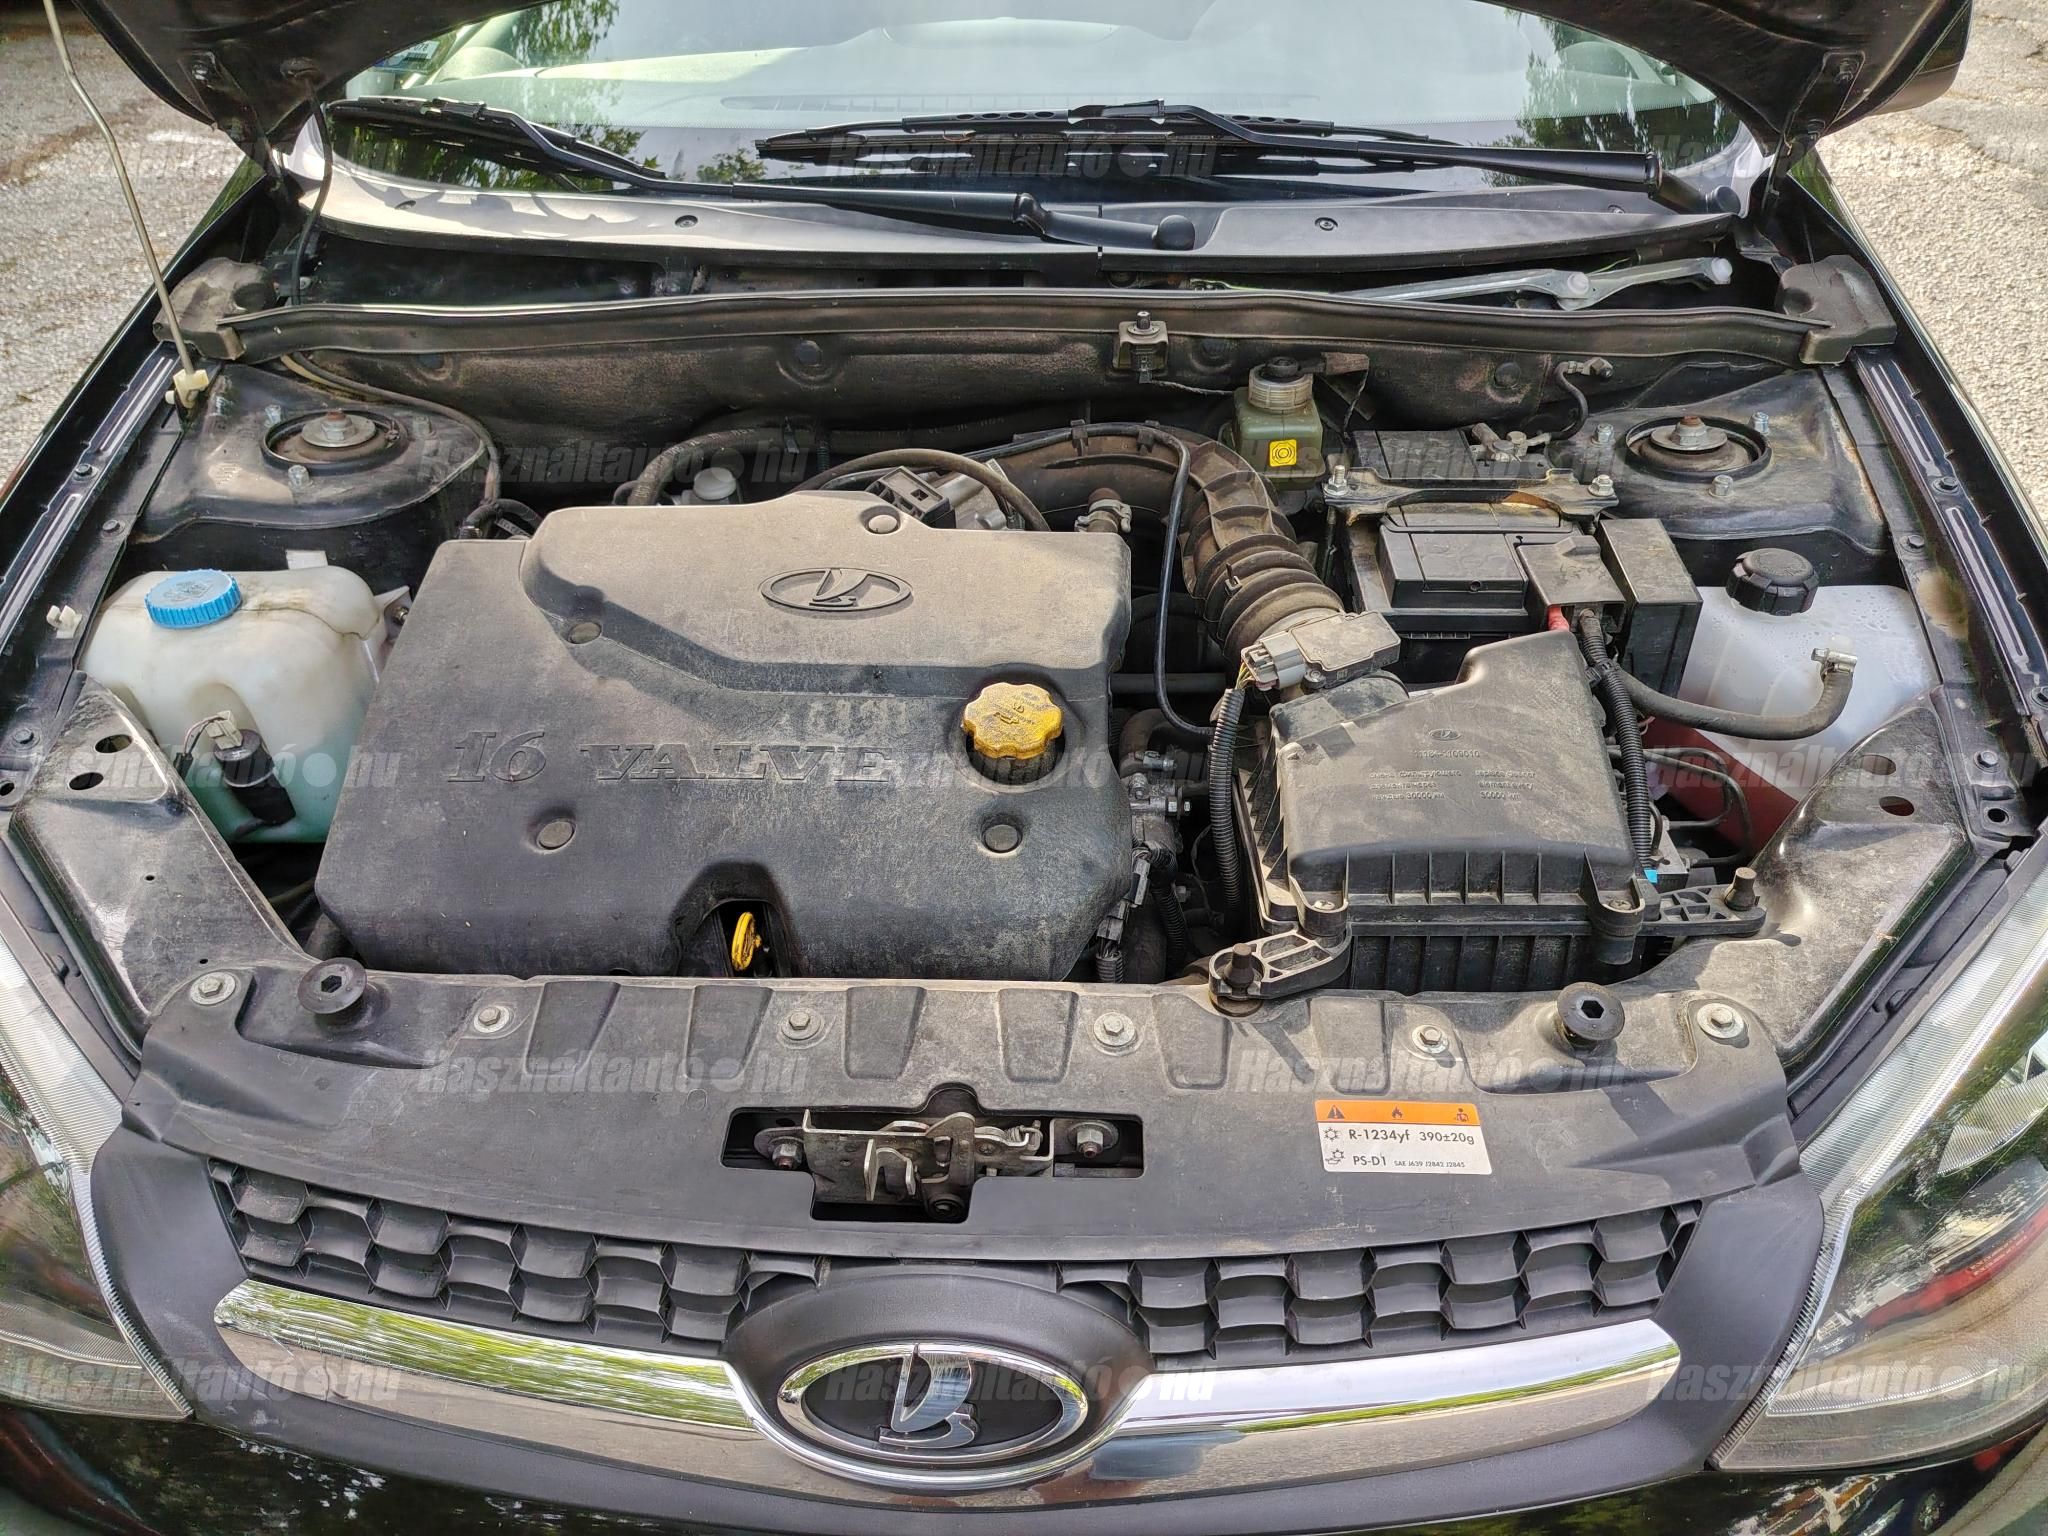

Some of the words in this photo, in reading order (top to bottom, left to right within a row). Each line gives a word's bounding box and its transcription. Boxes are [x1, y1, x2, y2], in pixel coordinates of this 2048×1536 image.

[447, 729, 547, 782] 16
[580, 743, 893, 782] VALVE
[1348, 1128, 1410, 1144] R-1234yf
[1419, 1131, 1475, 1146] 390±20g
[1352, 1155, 1387, 1167] PS-D1
